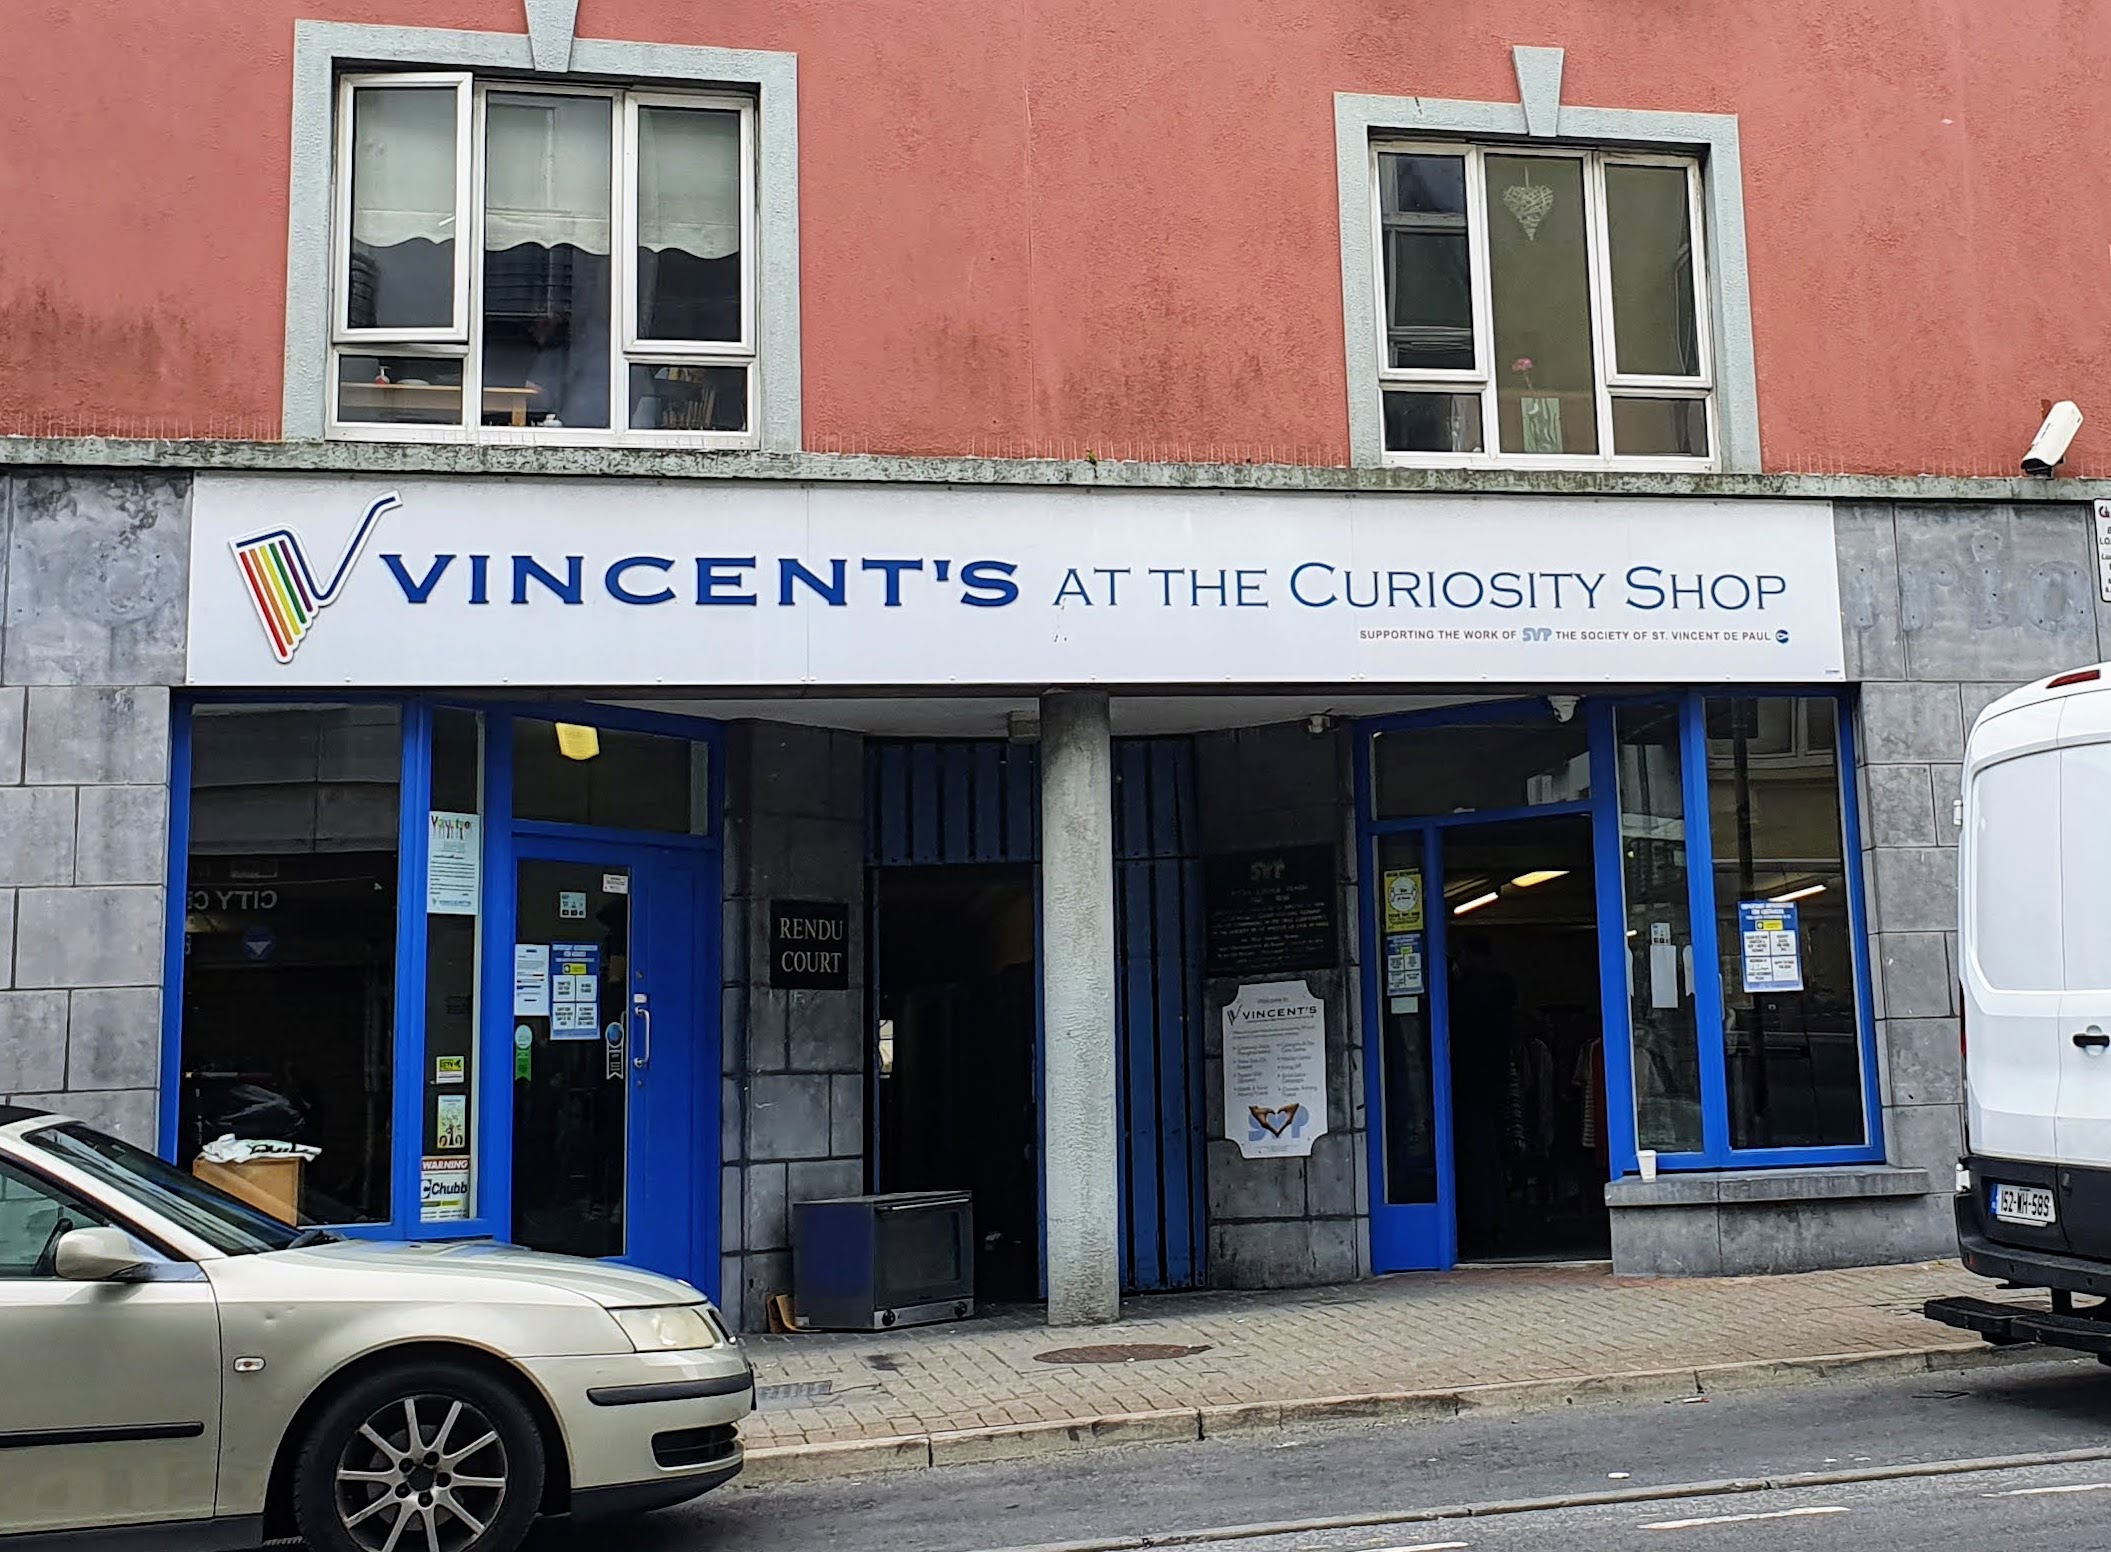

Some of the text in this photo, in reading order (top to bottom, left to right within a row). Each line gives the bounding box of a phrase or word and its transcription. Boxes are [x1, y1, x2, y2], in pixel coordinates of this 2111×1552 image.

[379, 553, 1787, 611] VINCENT'S AT THE CURIOSITY SHOP
[1360, 627, 1771, 642] SUPPORTING THE WORK OF SVP THE SOCIETY OF ST. VINCENT DE PAUL
[780, 917, 843, 940] RENDU
[781, 951, 842, 973] COURT
[1243, 1006, 1317, 1020] VINCENT'S
[423, 1160, 468, 1169] WARNING
[431, 1182, 468, 1195] Chubb
